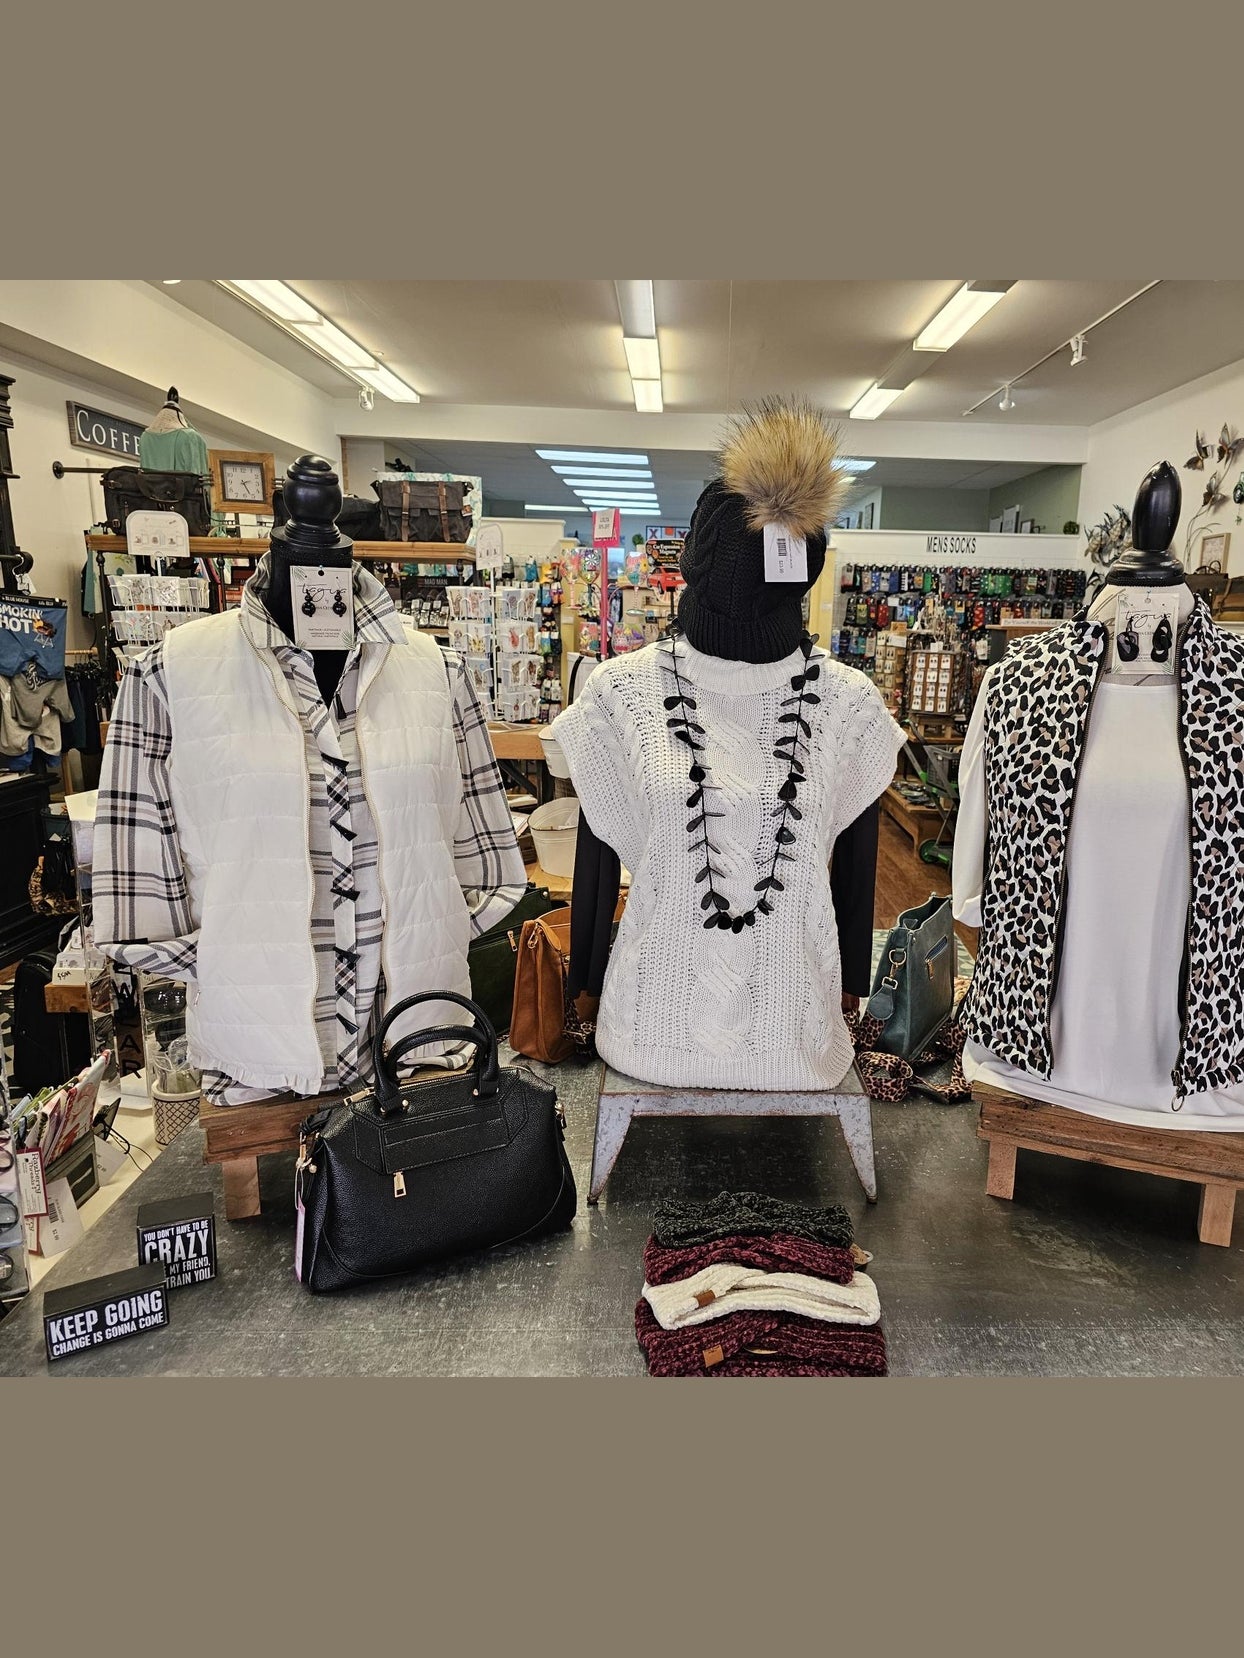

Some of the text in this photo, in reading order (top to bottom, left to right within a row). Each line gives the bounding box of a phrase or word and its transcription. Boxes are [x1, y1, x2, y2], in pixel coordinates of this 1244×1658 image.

[77, 409, 141, 456] COFFE
[926, 537, 977, 554] MENS SOCKS
[0, 614, 33, 634] HOT
[143, 1220, 209, 1242] YOU DON'T HAVE TO BE
[144, 1229, 209, 1264] CRAZY
[169, 1256, 211, 1275] MY FRIEND.
[166, 1271, 192, 1290] TRAIN
[49, 1290, 163, 1344] KEEP GOING
[52, 1311, 164, 1356] CHANGE IS GONNA COME
